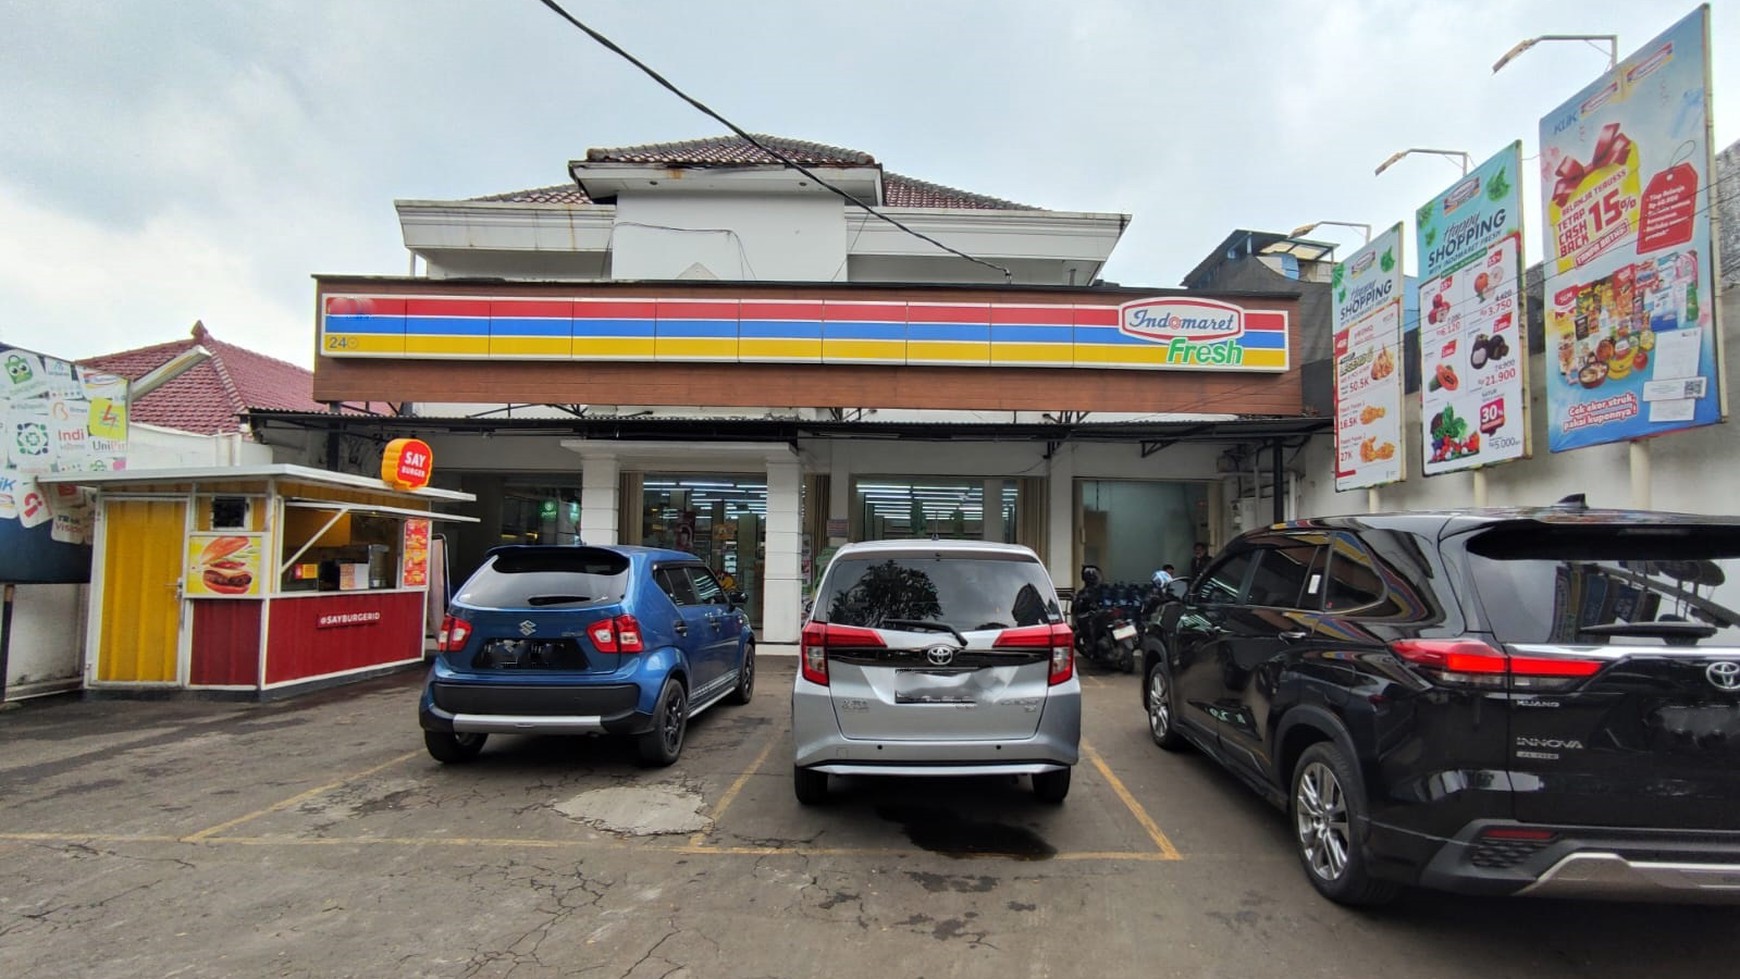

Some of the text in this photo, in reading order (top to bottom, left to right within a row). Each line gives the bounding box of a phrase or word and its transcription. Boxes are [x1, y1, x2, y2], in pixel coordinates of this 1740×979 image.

[1558, 208, 1585, 232] TETAP
[1589, 188, 1637, 233] 15%
[1428, 208, 1506, 268] SHOPPING
[1559, 220, 1588, 246] CASH
[1560, 233, 1589, 258] BACK
[1340, 279, 1392, 320] SHOPPING
[1129, 309, 1234, 331] Indomaret
[329, 337, 348, 349] 24
[1167, 337, 1243, 365] Fresh
[1569, 405, 1585, 416] Cek
[1565, 417, 1587, 431] pakai
[58, 429, 84, 441] Indi
[404, 451, 427, 468] SAY
[401, 466, 425, 478] BURGER
[1516, 736, 1584, 749] INNOVA
